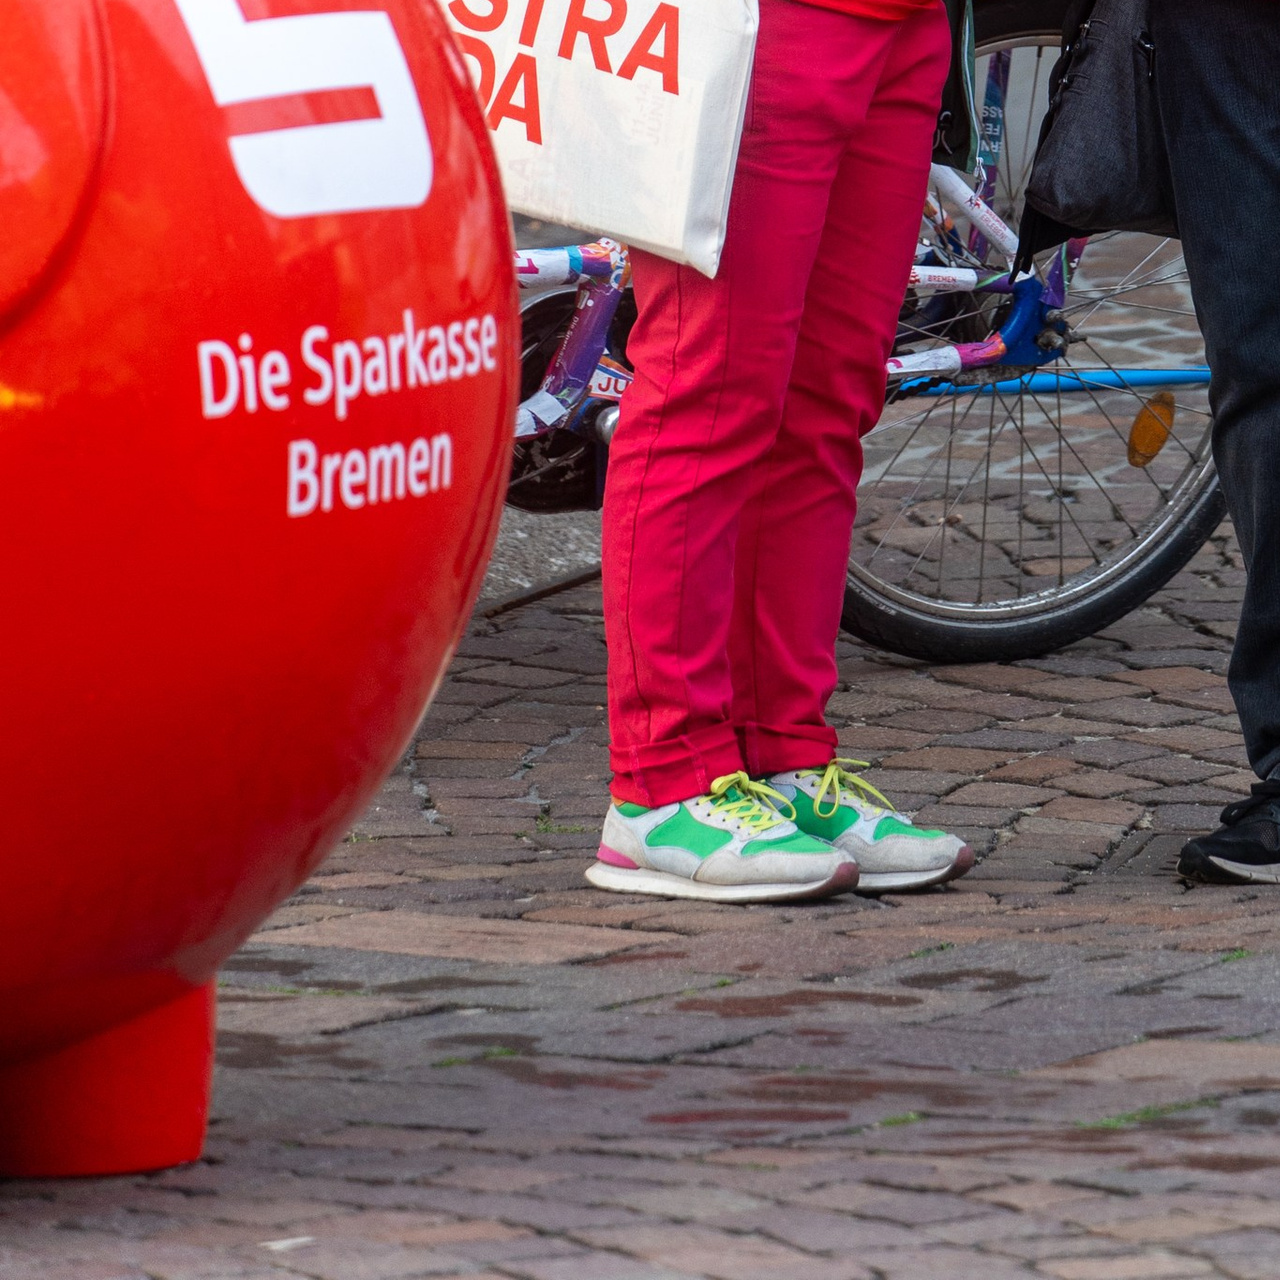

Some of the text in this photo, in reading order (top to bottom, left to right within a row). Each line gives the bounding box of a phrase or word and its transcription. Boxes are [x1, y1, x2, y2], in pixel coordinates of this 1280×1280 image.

[926, 274, 957, 283] BREMEN
[197, 308, 498, 422] Die Sparkasse
[287, 432, 452, 519] Bremen
